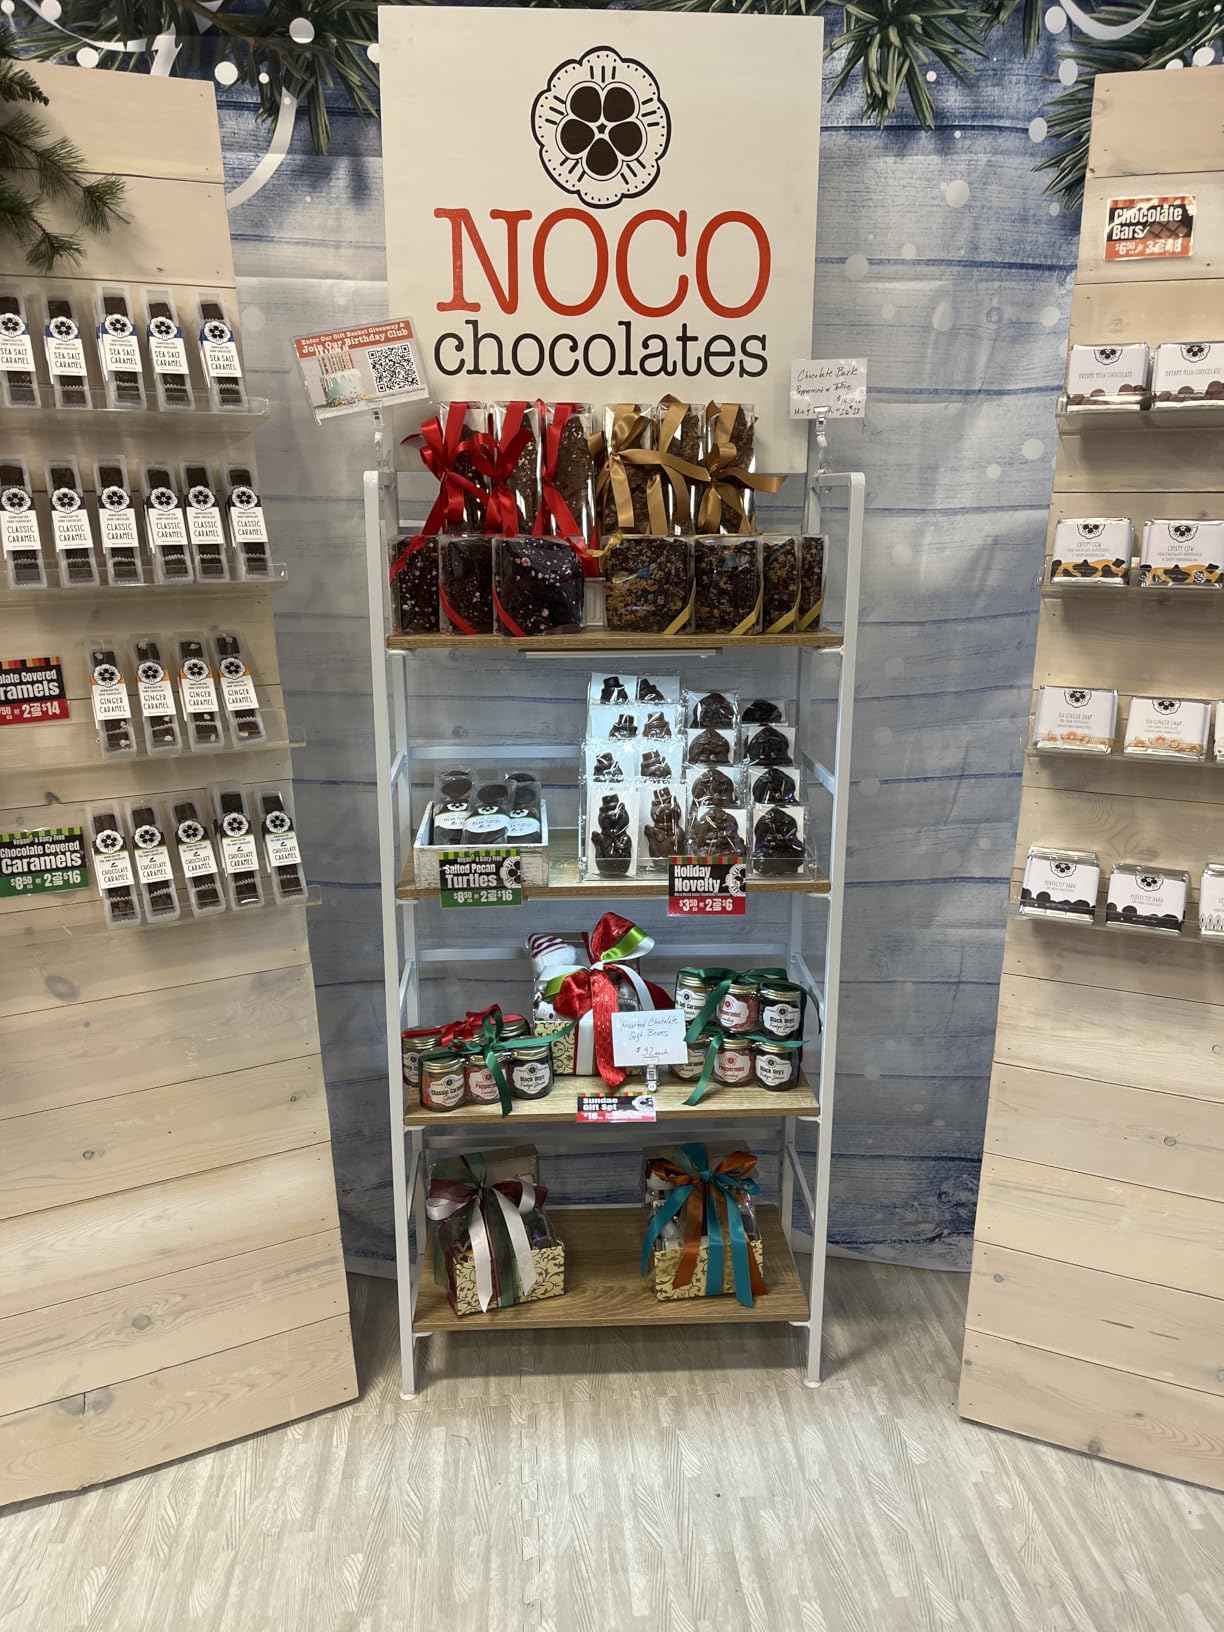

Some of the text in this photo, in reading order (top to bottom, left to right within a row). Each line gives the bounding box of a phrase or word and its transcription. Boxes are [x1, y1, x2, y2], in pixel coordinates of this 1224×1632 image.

[1114, 206, 1182, 224] Chocolate
[1112, 225, 1142, 240] Bars
[434, 208, 771, 318] NOCO
[301, 337, 319, 345] Enter
[346, 329, 368, 338] Basket
[369, 324, 398, 334] Giveaway
[302, 328, 408, 354] Join Our Birthday Club
[14, 348, 28, 356] SALT
[123, 348, 136, 357] SALT
[434, 320, 768, 378] chocolates
[67, 352, 81, 360] SALT
[168, 351, 181, 359] SALT
[222, 355, 235, 363] SALT
[1, 356, 30, 365] CARAMEL
[55, 361, 83, 369] CARAMEL
[110, 356, 138, 366] CARAMEL
[156, 359, 183, 368] CARAMEL
[211, 363, 237, 371] CARAMEL
[797, 366, 833, 382] Chocolate
[1195, 368, 1221, 376] CHOCOLATE
[58, 524, 86, 532] CLASSIC
[106, 523, 133, 531] CLASSIC
[156, 522, 182, 530] CLASSIC
[193, 521, 219, 529] CLASSIC
[237, 520, 262, 528] CLASSIC
[7, 525, 35, 534] CLASSIC
[194, 530, 220, 538] CARAMEL
[238, 528, 264, 536] CARAMEL
[8, 534, 37, 543] CARAMEL
[59, 533, 88, 542] CARAMEL
[108, 532, 135, 541] CARAMEL
[157, 530, 184, 539] CARAMEL
[21, 669, 57, 682] Covered
[228, 688, 250, 696] GINGER
[100, 697, 123, 705] GINGER
[144, 694, 167, 702] GINGER
[228, 696, 254, 705] CARAMEL
[100, 705, 127, 714] CARAMEL
[144, 702, 170, 710] CARAMEL
[22, 704, 31, 718] 2
[0, 840, 80, 859] Chocolate Covered
[272, 846, 297, 855] CHOCOLATE
[228, 851, 254, 860] CHOCOLATE
[274, 854, 298, 862] CARAMEL
[2, 852, 82, 874] Caramels
[185, 856, 211, 865] CHOCOLATE
[230, 858, 254, 868] CARAMEL
[102, 866, 129, 876] CHOCOLATE
[141, 862, 167, 871] CHOCOLATE
[188, 863, 212, 872] CARAMEL
[445, 864, 496, 875] Salted Pecan
[143, 868, 168, 878] CARAMEL
[674, 865, 712, 879] Holiday
[44, 874, 53, 887] 2
[64, 870, 81, 884] $16
[104, 874, 130, 883] CARAMEL
[445, 874, 498, 889] Turtles
[674, 878, 721, 894] Novelty
[480, 891, 488, 902] 2
[498, 890, 513, 902] $16
[706, 898, 713, 912] 2
[722, 898, 733, 911] $6
[648, 1016, 679, 1027] Chocolate
[648, 1029, 669, 1037] Boxes
[760, 1066, 771, 1074] Black
